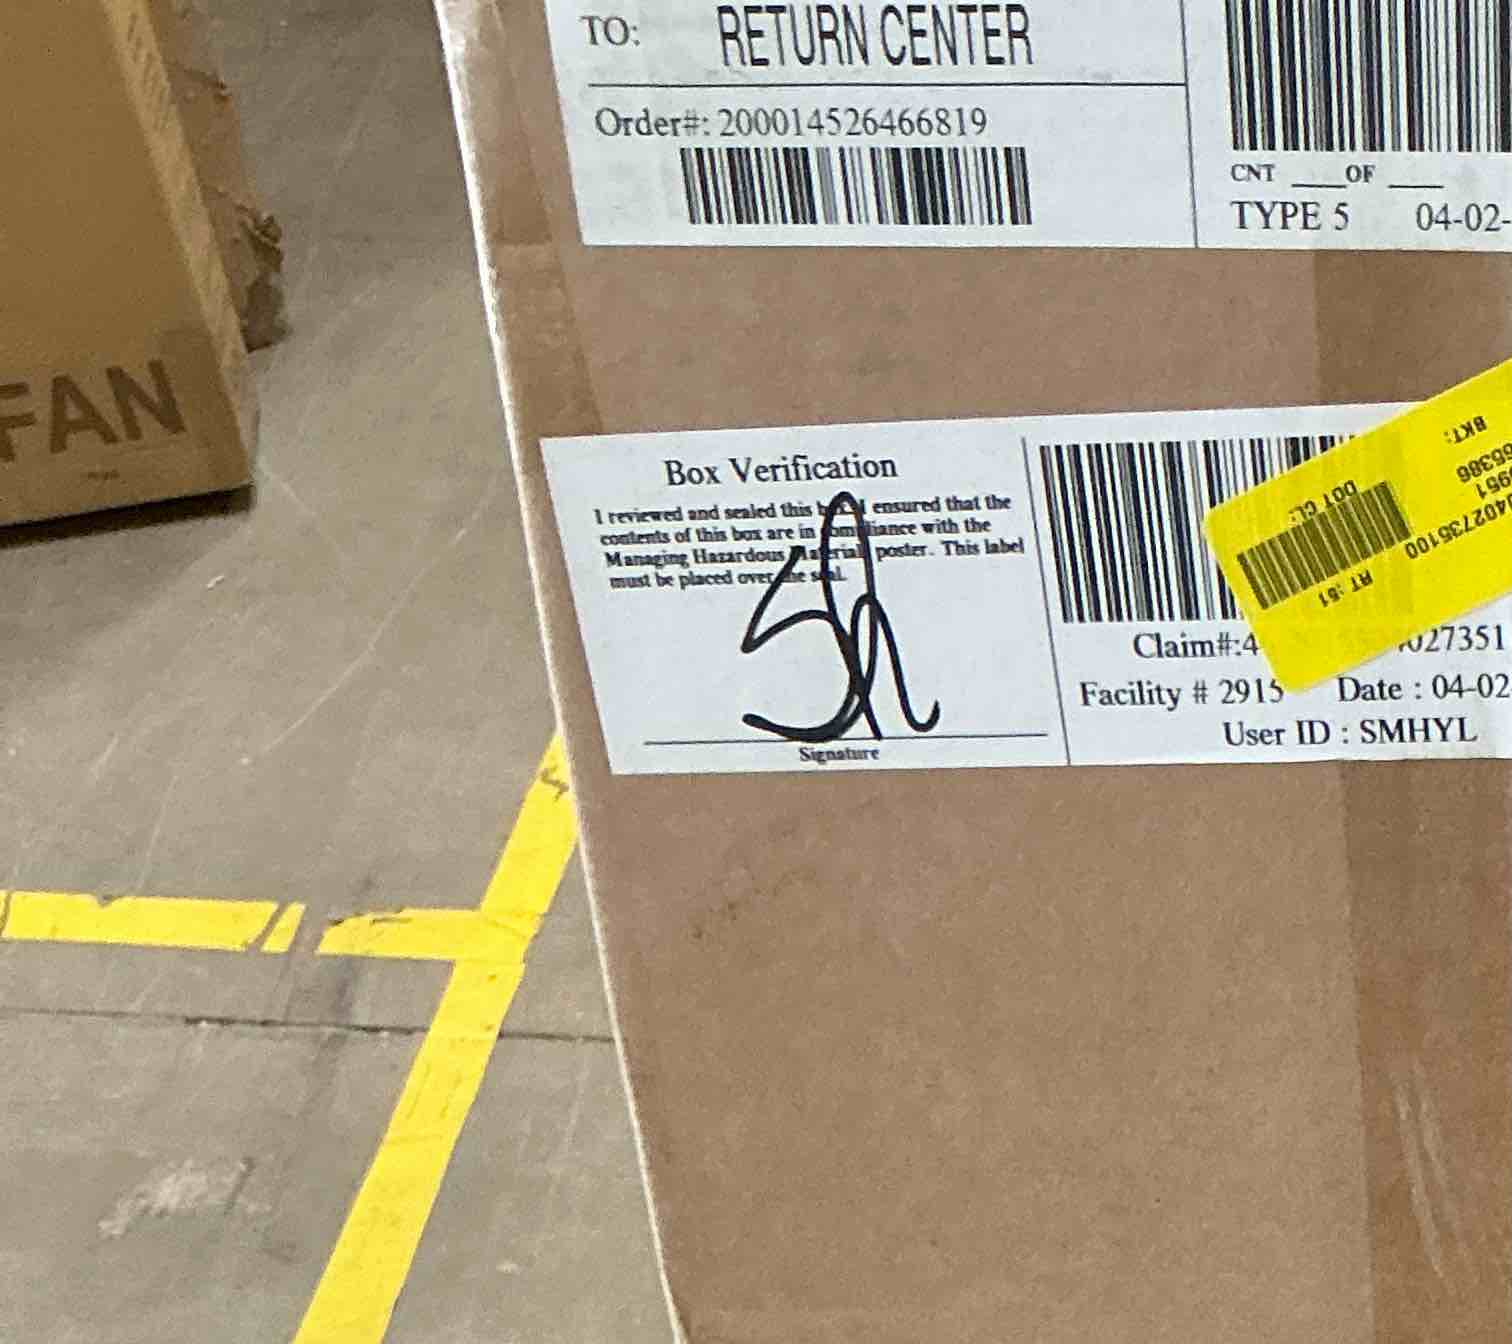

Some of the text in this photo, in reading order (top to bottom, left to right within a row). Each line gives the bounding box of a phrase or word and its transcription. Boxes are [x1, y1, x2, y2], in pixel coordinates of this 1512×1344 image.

[581, 4, 1034, 67] TO: RETURN CENTER
[595, 107, 988, 138] Order#: 200014526466819
[1231, 163, 1376, 184] CNT OF
[1231, 201, 1351, 232] TYPE 5
[665, 453, 899, 486] Box Verification
[608, 507, 684, 524] reviewed
[687, 505, 720, 521] and
[724, 503, 777, 520] sealed
[780, 502, 813, 518] this
[873, 496, 941, 514] ensured
[946, 495, 980, 512] that
[985, 494, 1011, 511] the
[600, 517, 991, 546] contents of this box are in with the
[605, 537, 1025, 569] Managing Hazardous poster. This label
[610, 573, 650, 589] must
[655, 572, 673, 588] be
[680, 570, 733, 590] placed
[1079, 680, 1181, 712] Facility
[1192, 681, 1210, 705] #
[1336, 676, 1403, 702] Date
[1223, 717, 1479, 747] User ID SMHYL
[799, 745, 881, 763] Signature
